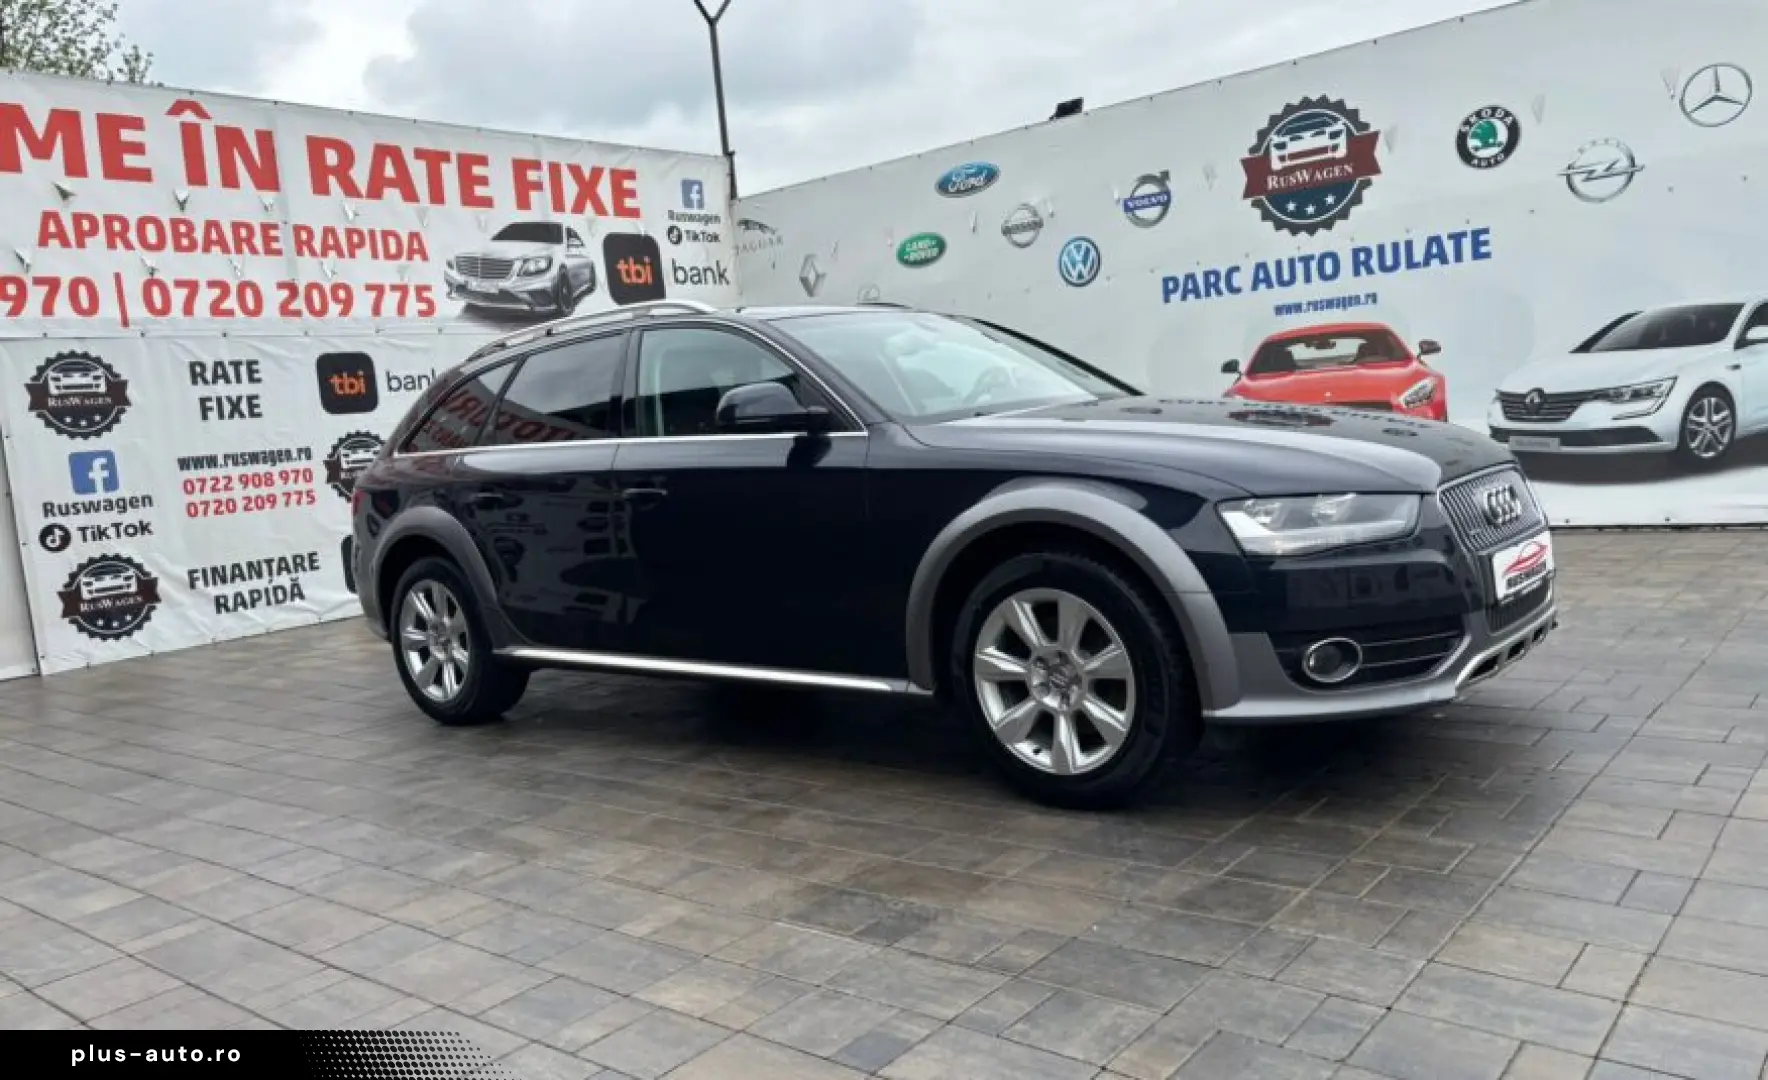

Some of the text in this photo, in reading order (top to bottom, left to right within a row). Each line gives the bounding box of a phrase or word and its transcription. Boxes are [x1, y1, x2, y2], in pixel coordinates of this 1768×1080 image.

[0, 99, 641, 218] ME ÎN RATE FIXE
[38, 209, 430, 261] APROBARE RAPIDA
[684, 229, 722, 243] TikTok
[616, 255, 731, 286] tbi bank
[1161, 227, 1493, 304] PARC AUTO RULATE
[0, 275, 99, 318] 970
[142, 277, 264, 318] 0720
[276, 278, 354, 318] 209
[364, 283, 437, 318] 775
[188, 358, 263, 387] RATE
[328, 370, 366, 396] tbi
[198, 393, 263, 421] FIXE
[177, 446, 312, 471] www.ruswagen.ro
[183, 467, 314, 495] 0722 908 970
[42, 493, 155, 519] Ruswagen
[186, 489, 317, 518] 0720 209 775
[76, 519, 155, 544] TikTok
[213, 576, 306, 615] RAPIDĂ
